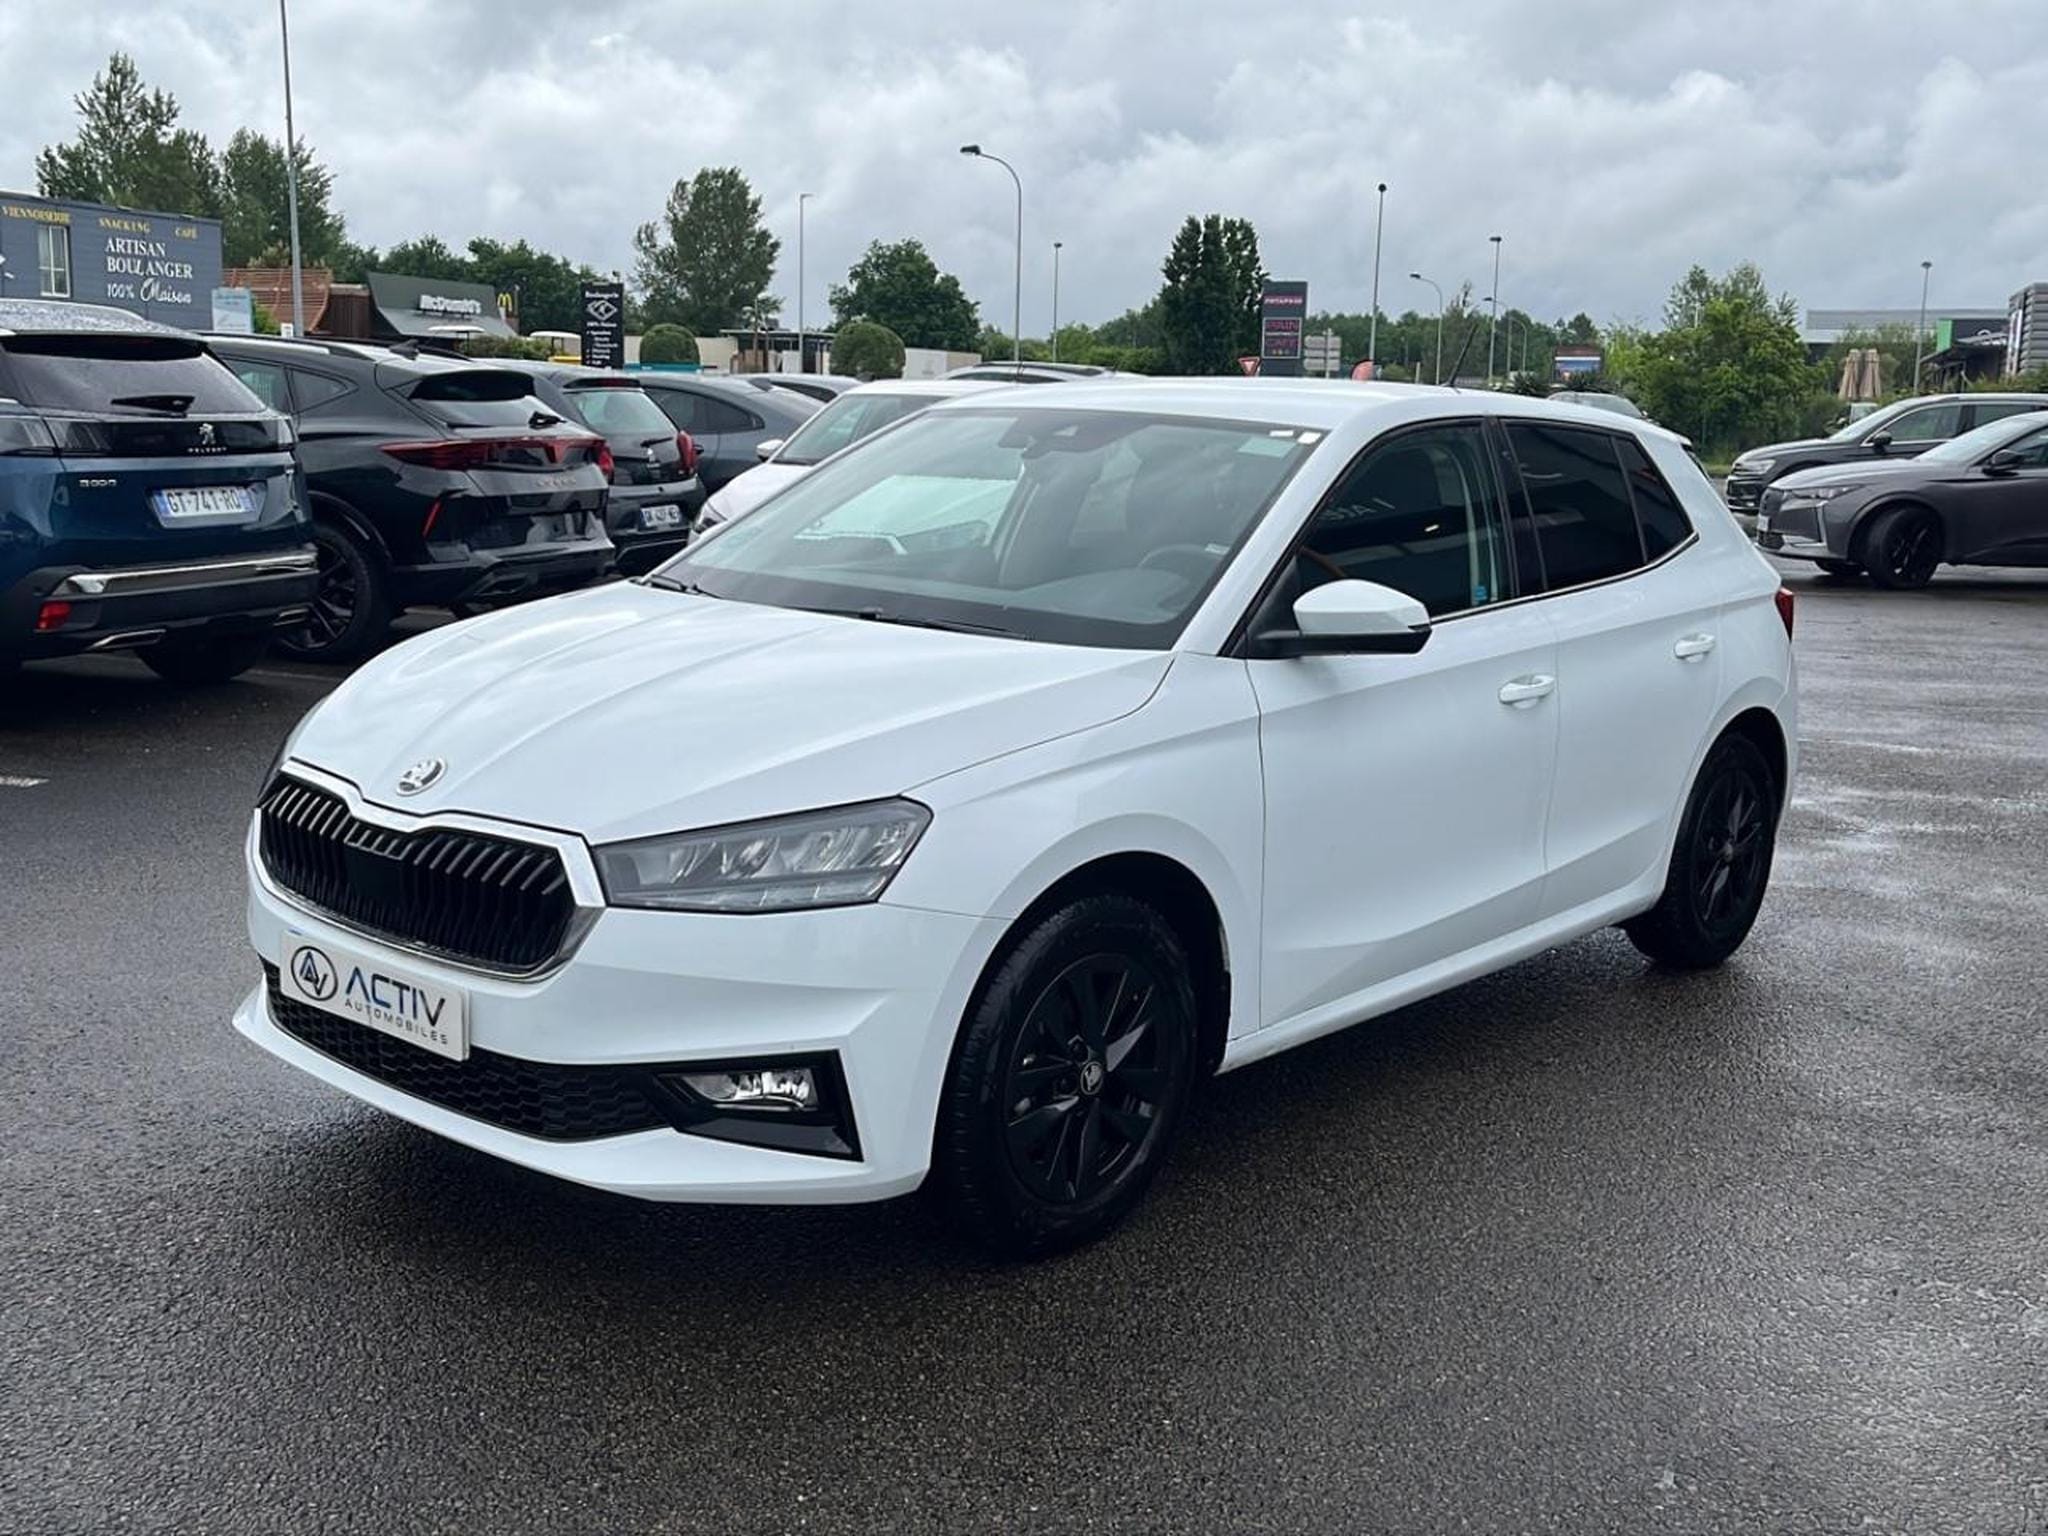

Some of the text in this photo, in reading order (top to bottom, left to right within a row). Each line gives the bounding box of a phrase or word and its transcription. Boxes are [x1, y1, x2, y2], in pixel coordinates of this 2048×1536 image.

[99, 218, 151, 233] SNACKING
[105, 237, 167, 257] ARTISAN
[106, 256, 193, 279] BOULANGER
[107, 282, 135, 299] 100%
[140, 278, 192, 304] Maison
[345, 966, 446, 1027] ACTIV
[345, 999, 448, 1045] AUTOMOBILES
